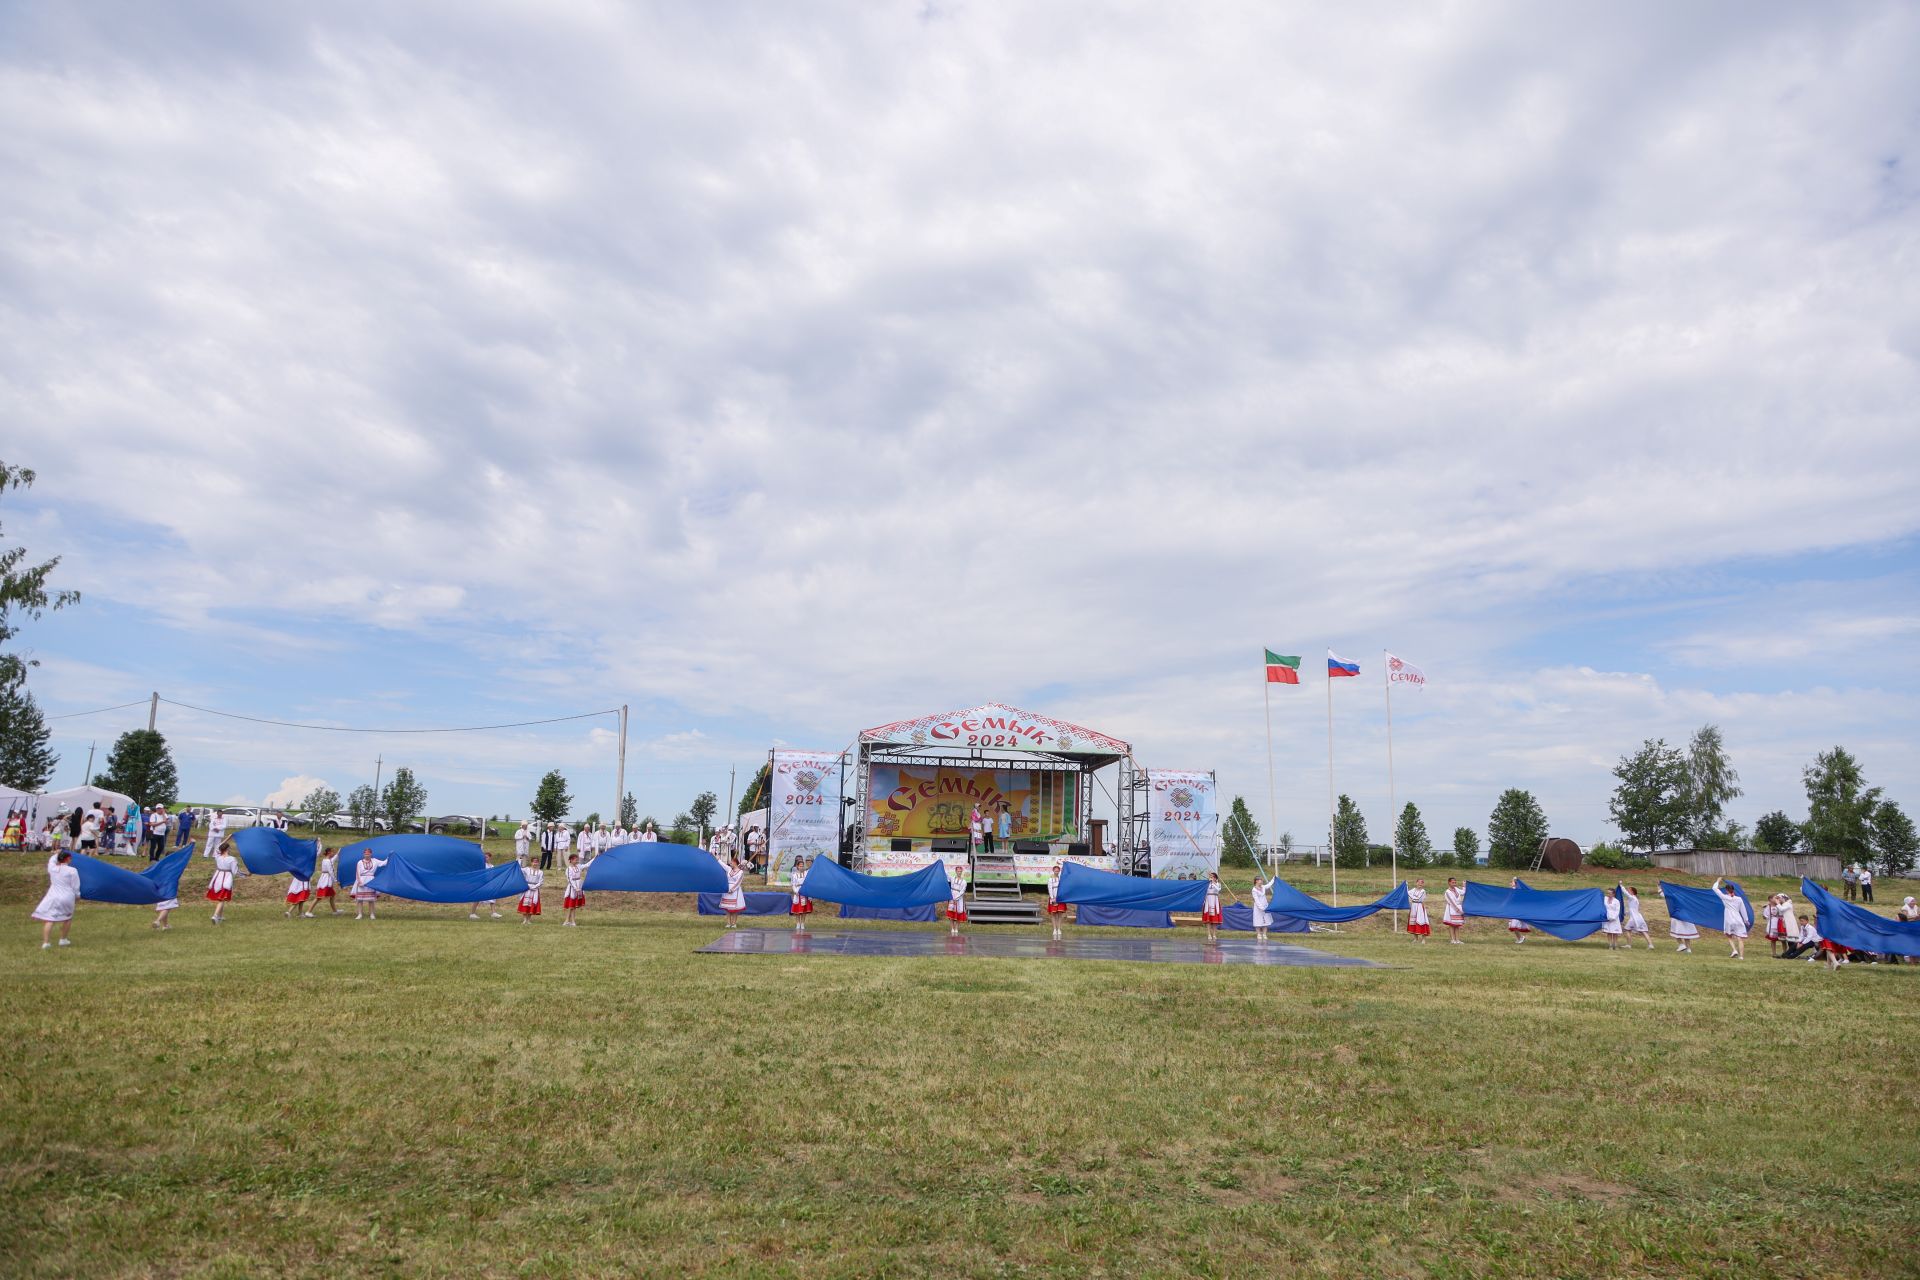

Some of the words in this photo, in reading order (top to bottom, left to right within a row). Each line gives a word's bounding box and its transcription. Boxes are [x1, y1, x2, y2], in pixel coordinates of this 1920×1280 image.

[967, 735, 1018, 747] 2024
[785, 794, 823, 805] 2024
[1164, 811, 1201, 821] 2024
